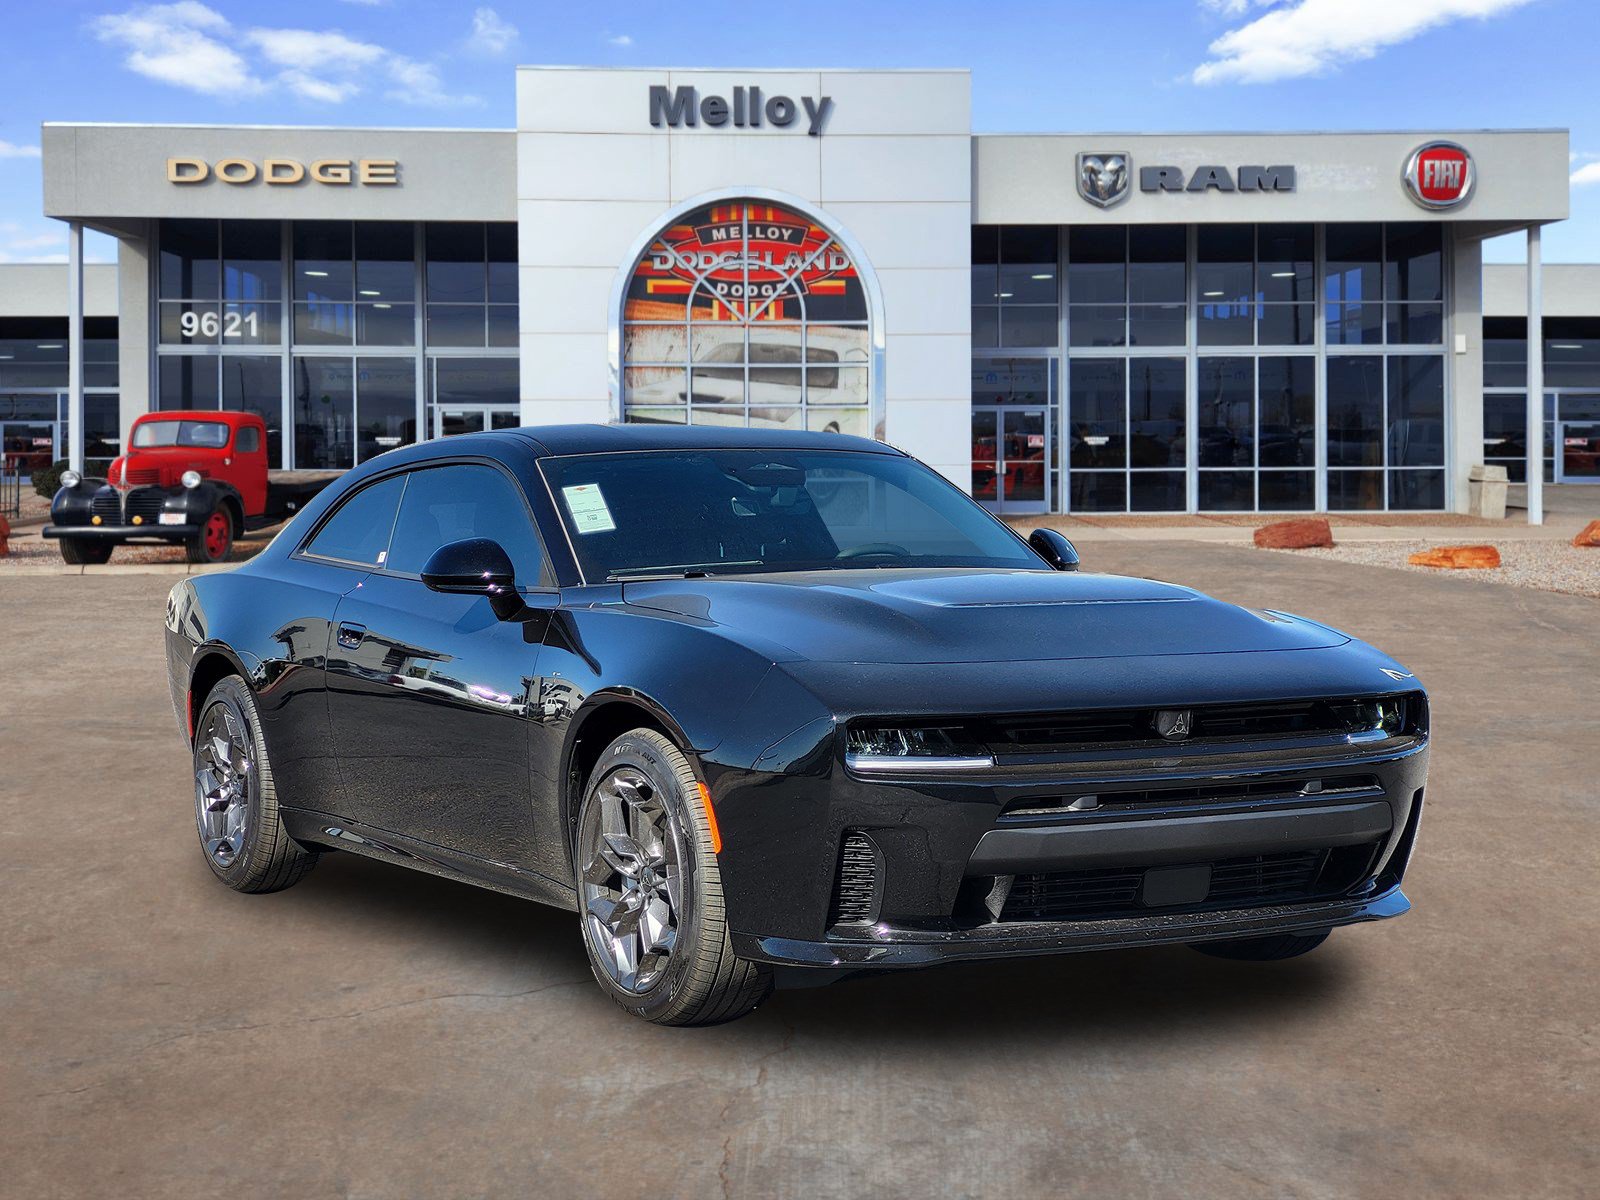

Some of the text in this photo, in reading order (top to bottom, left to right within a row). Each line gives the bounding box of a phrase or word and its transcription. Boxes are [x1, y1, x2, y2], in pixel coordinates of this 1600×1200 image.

[649, 85, 832, 136] Melloy
[167, 158, 398, 185] DODGE
[1140, 164, 1296, 192] RAM
[1423, 159, 1464, 189] FIAT
[181, 311, 258, 337] 9621
